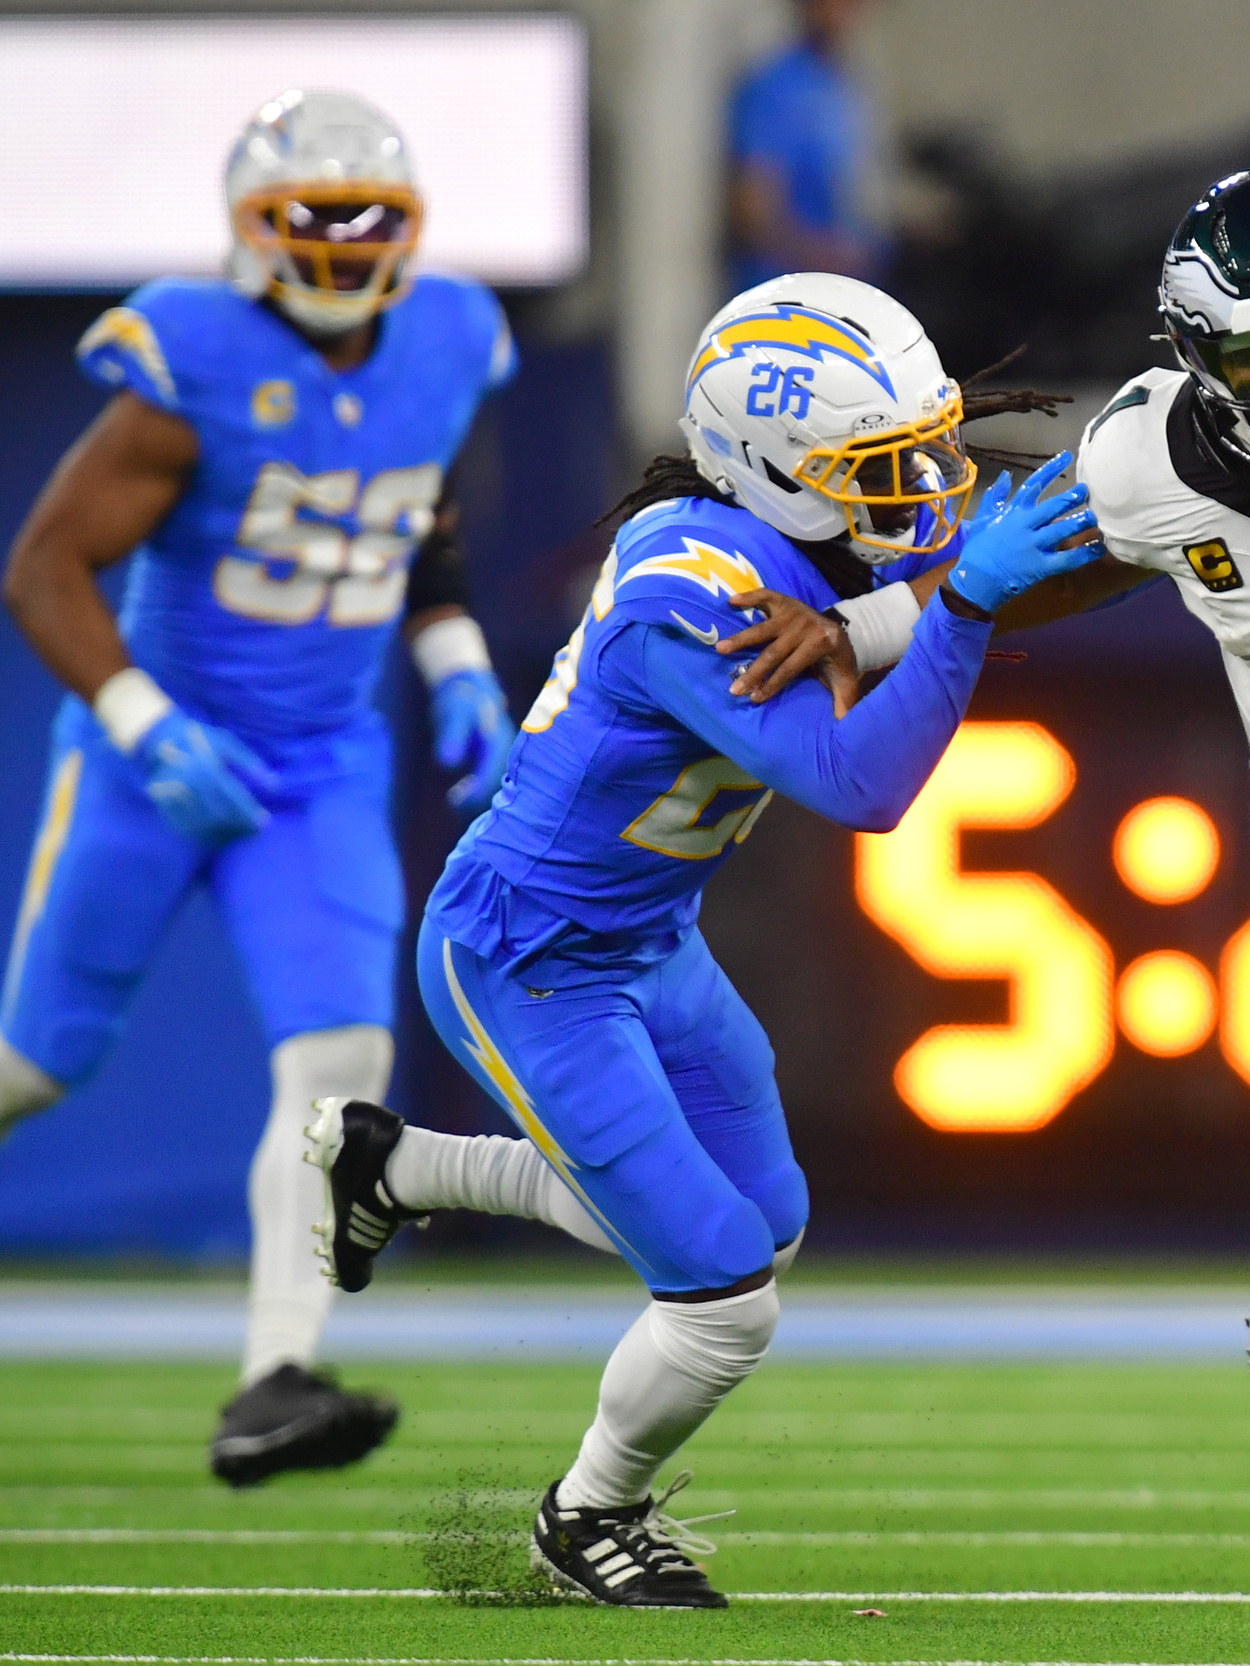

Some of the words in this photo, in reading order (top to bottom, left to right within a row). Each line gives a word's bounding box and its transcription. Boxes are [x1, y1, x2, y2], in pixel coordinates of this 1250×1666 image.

[746, 362, 815, 420] 26
[1187, 543, 1233, 580] C
[620, 753, 774, 861] 2
